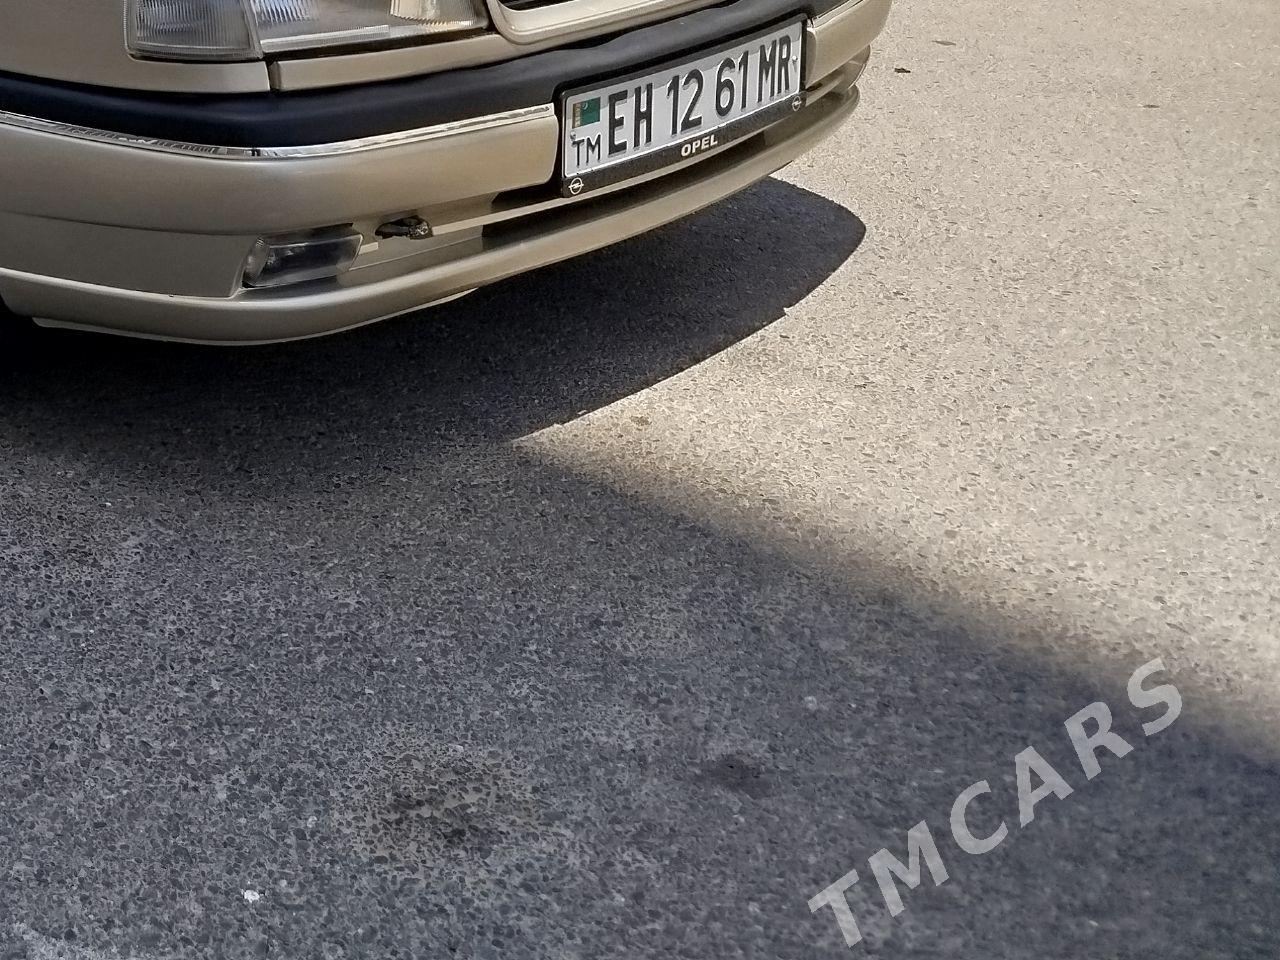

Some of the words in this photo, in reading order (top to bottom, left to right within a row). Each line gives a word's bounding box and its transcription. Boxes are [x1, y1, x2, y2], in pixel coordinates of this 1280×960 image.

[571, 133, 602, 168] TM
[608, 82, 654, 156] EH
[666, 68, 704, 137] 12
[714, 50, 749, 117] 61
[757, 34, 792, 103] MR
[680, 134, 718, 157] OPEL
